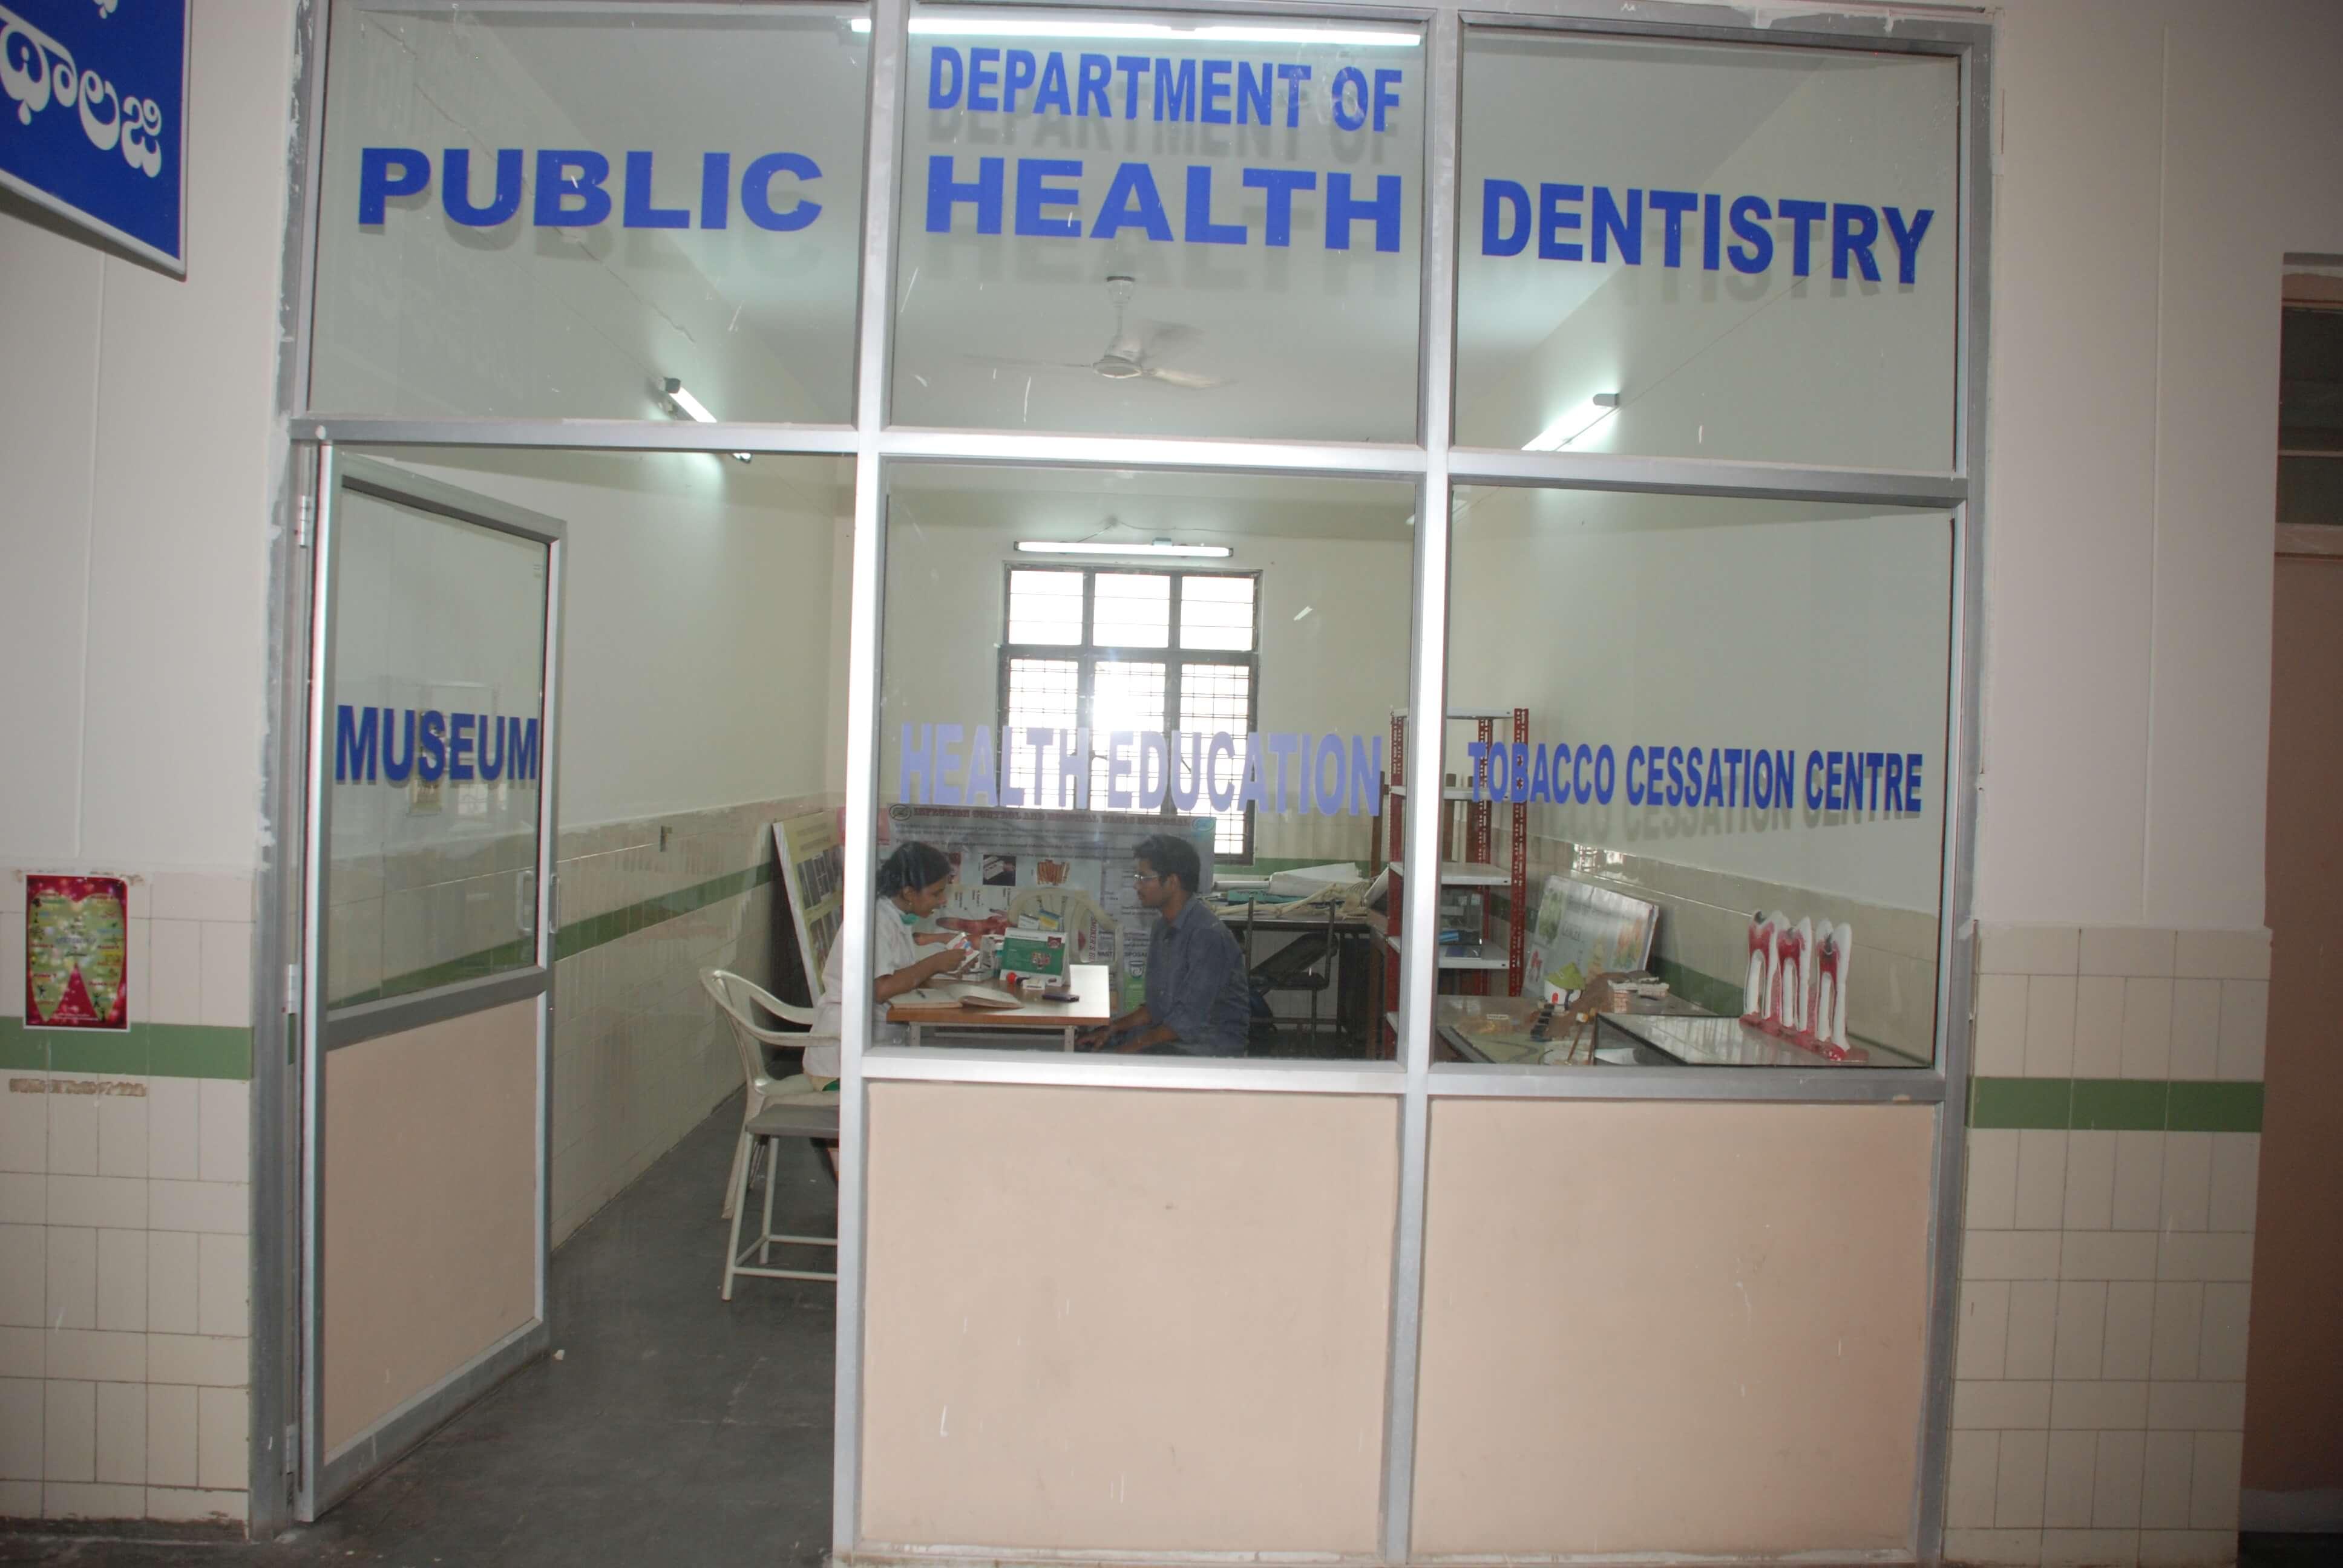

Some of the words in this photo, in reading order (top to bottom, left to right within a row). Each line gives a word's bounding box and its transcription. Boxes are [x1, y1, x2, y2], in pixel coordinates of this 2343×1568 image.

[928, 45, 1311, 128] DEPARTMENT
[1331, 66, 1403, 132] OF
[358, 148, 823, 232] PUBLIC
[925, 155, 1402, 253] HEALTH
[1481, 178, 1935, 284] DENTISTRY
[336, 705, 538, 782] MUSEUM
[899, 722, 1088, 810] HEALTH
[1106, 730, 1382, 817] EDUCATION
[1468, 742, 1615, 805] TOBACCO
[1626, 746, 1795, 809] CESSATION
[1806, 750, 1923, 812] CENTRE
